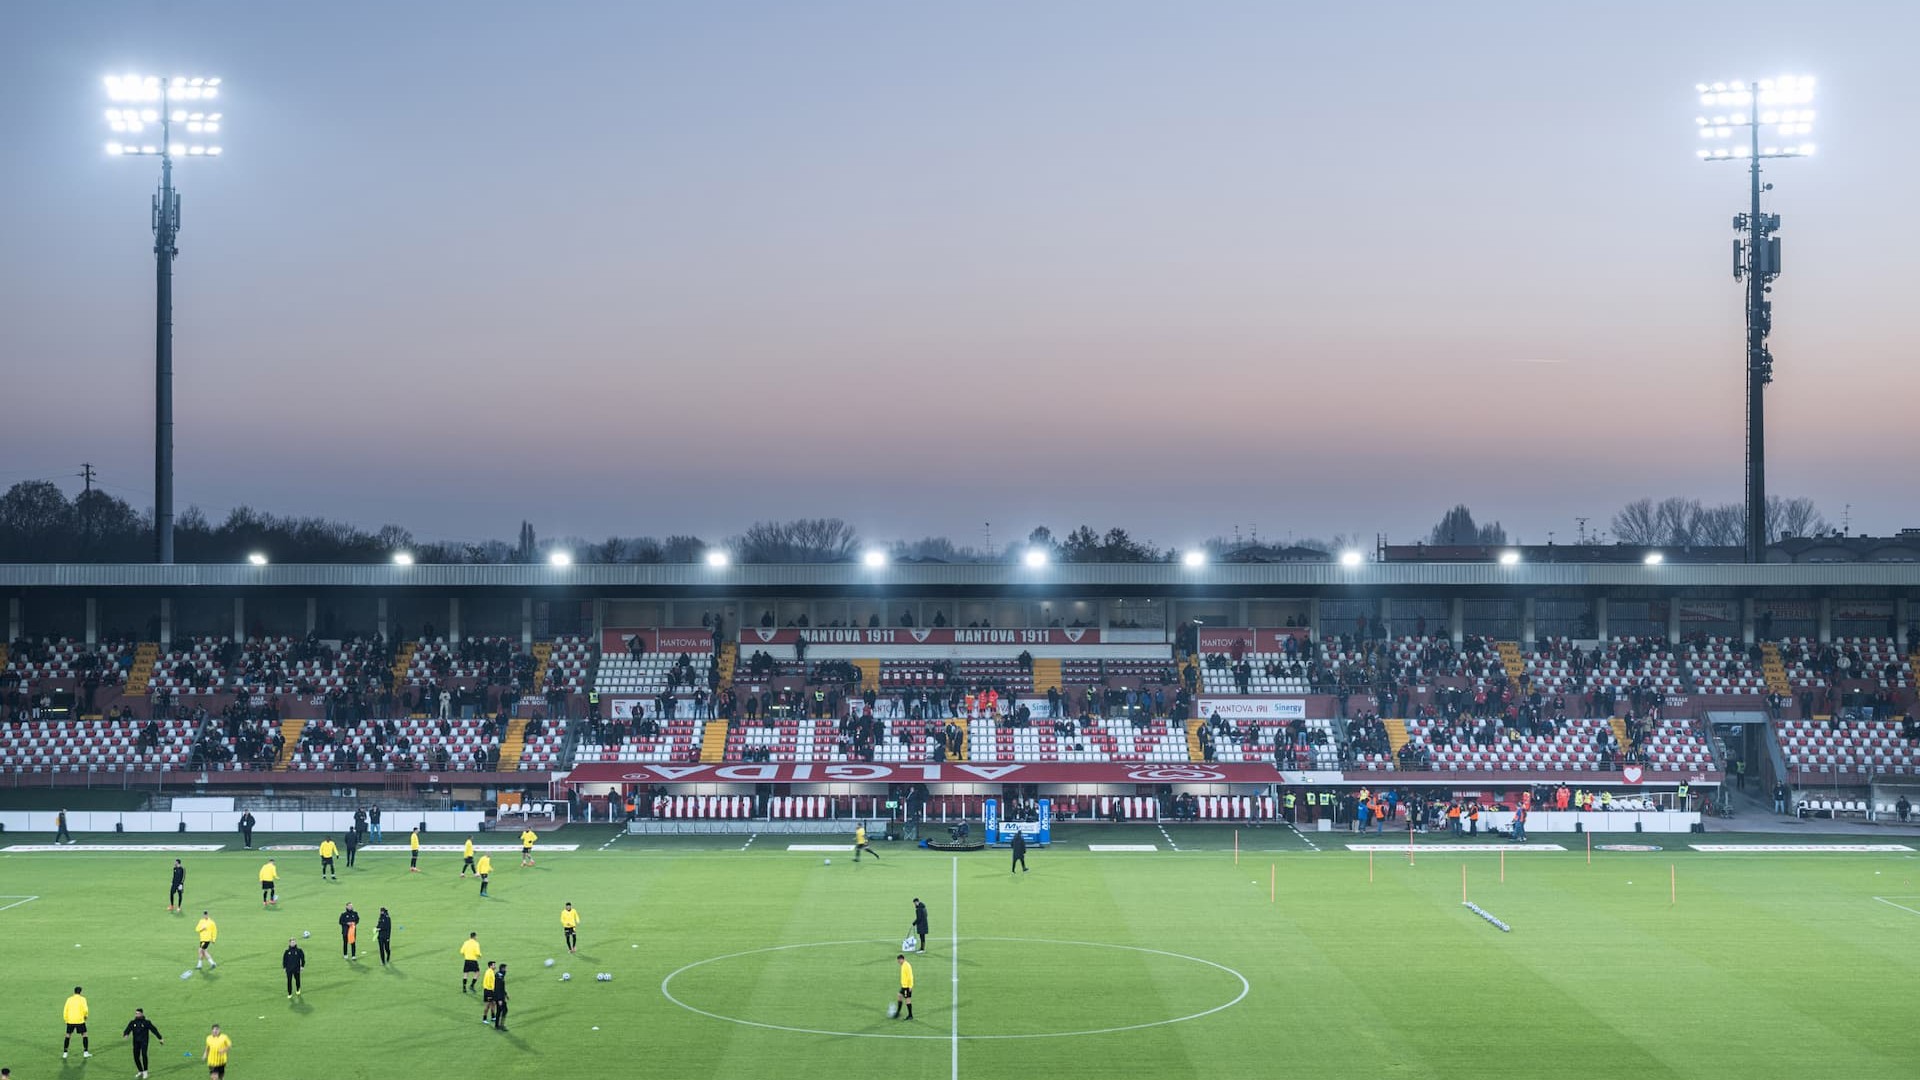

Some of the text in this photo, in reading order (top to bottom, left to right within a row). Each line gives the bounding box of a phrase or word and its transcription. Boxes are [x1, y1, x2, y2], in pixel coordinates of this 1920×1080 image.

[800, 629, 895, 642] MANTOVA 1911
[954, 629, 1049, 642] MANTOVA 1911
[660, 638, 697, 647] MANTOVA
[1201, 639, 1239, 647] MANTOV
[1215, 704, 1253, 713] MANTOVA
[1274, 702, 1302, 713] Sinergy
[643, 764, 1027, 780] ALGIDA
